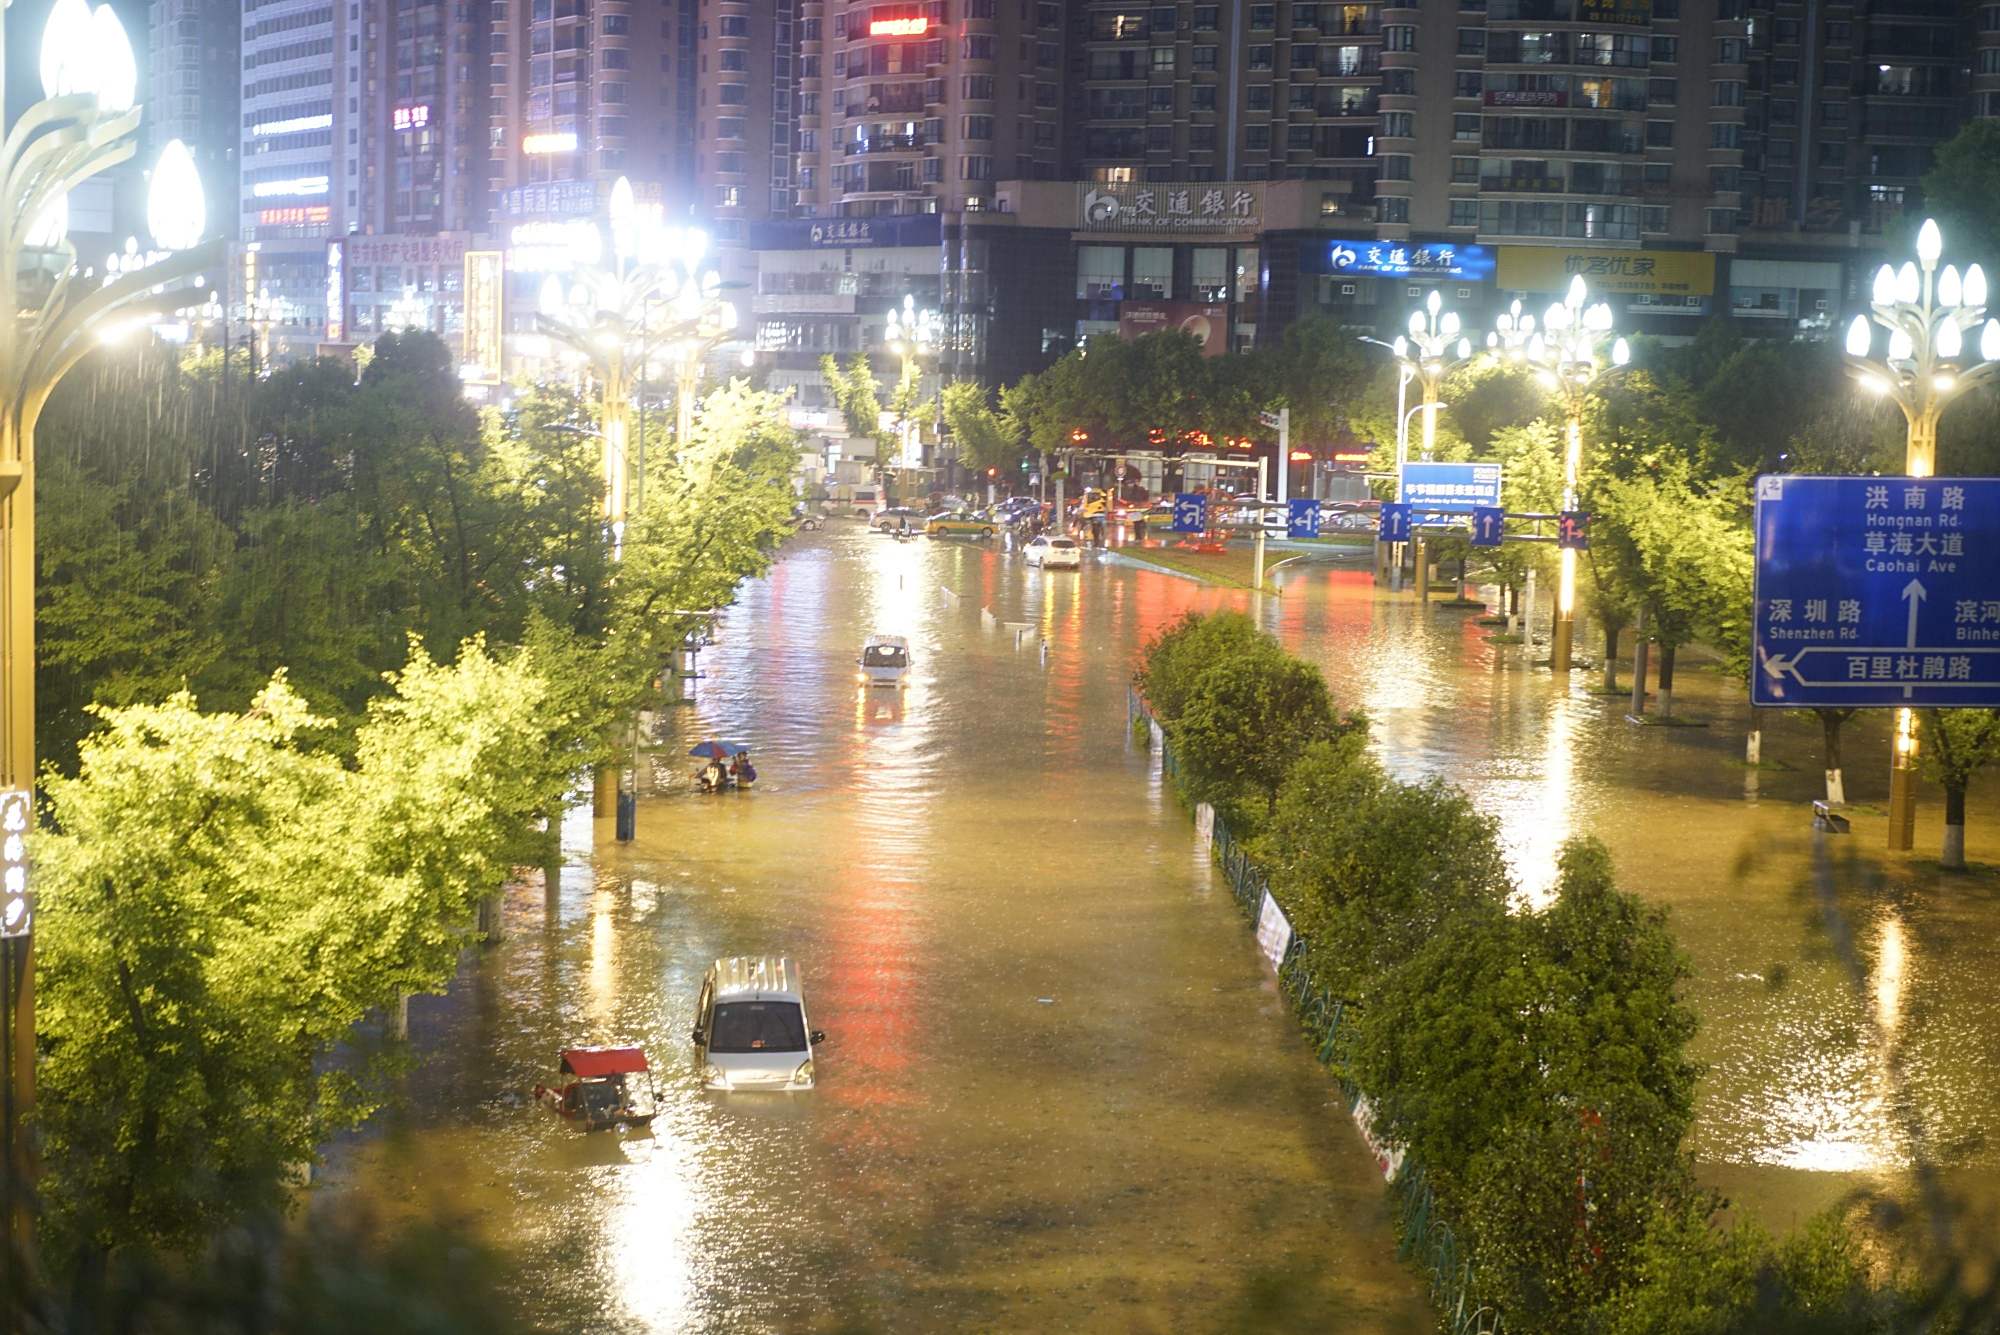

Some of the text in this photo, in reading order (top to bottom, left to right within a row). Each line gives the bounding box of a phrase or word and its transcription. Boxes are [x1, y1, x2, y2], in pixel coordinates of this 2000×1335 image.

[1135, 189, 1255, 216] 交通銀行
[1367, 246, 1456, 267] 交通銀行
[1865, 486, 1966, 510] 洪南路
[1867, 513, 1932, 530] Hongnan
[1864, 531, 1965, 556] 草海大道
[1865, 559, 1956, 573] Caohai Ave
[1769, 598, 1862, 624] 深圳路
[1954, 600, 2000, 624] 滨河
[1769, 627, 1835, 640] Shenzhen
[1847, 656, 1972, 680] 百里杜鹃路
